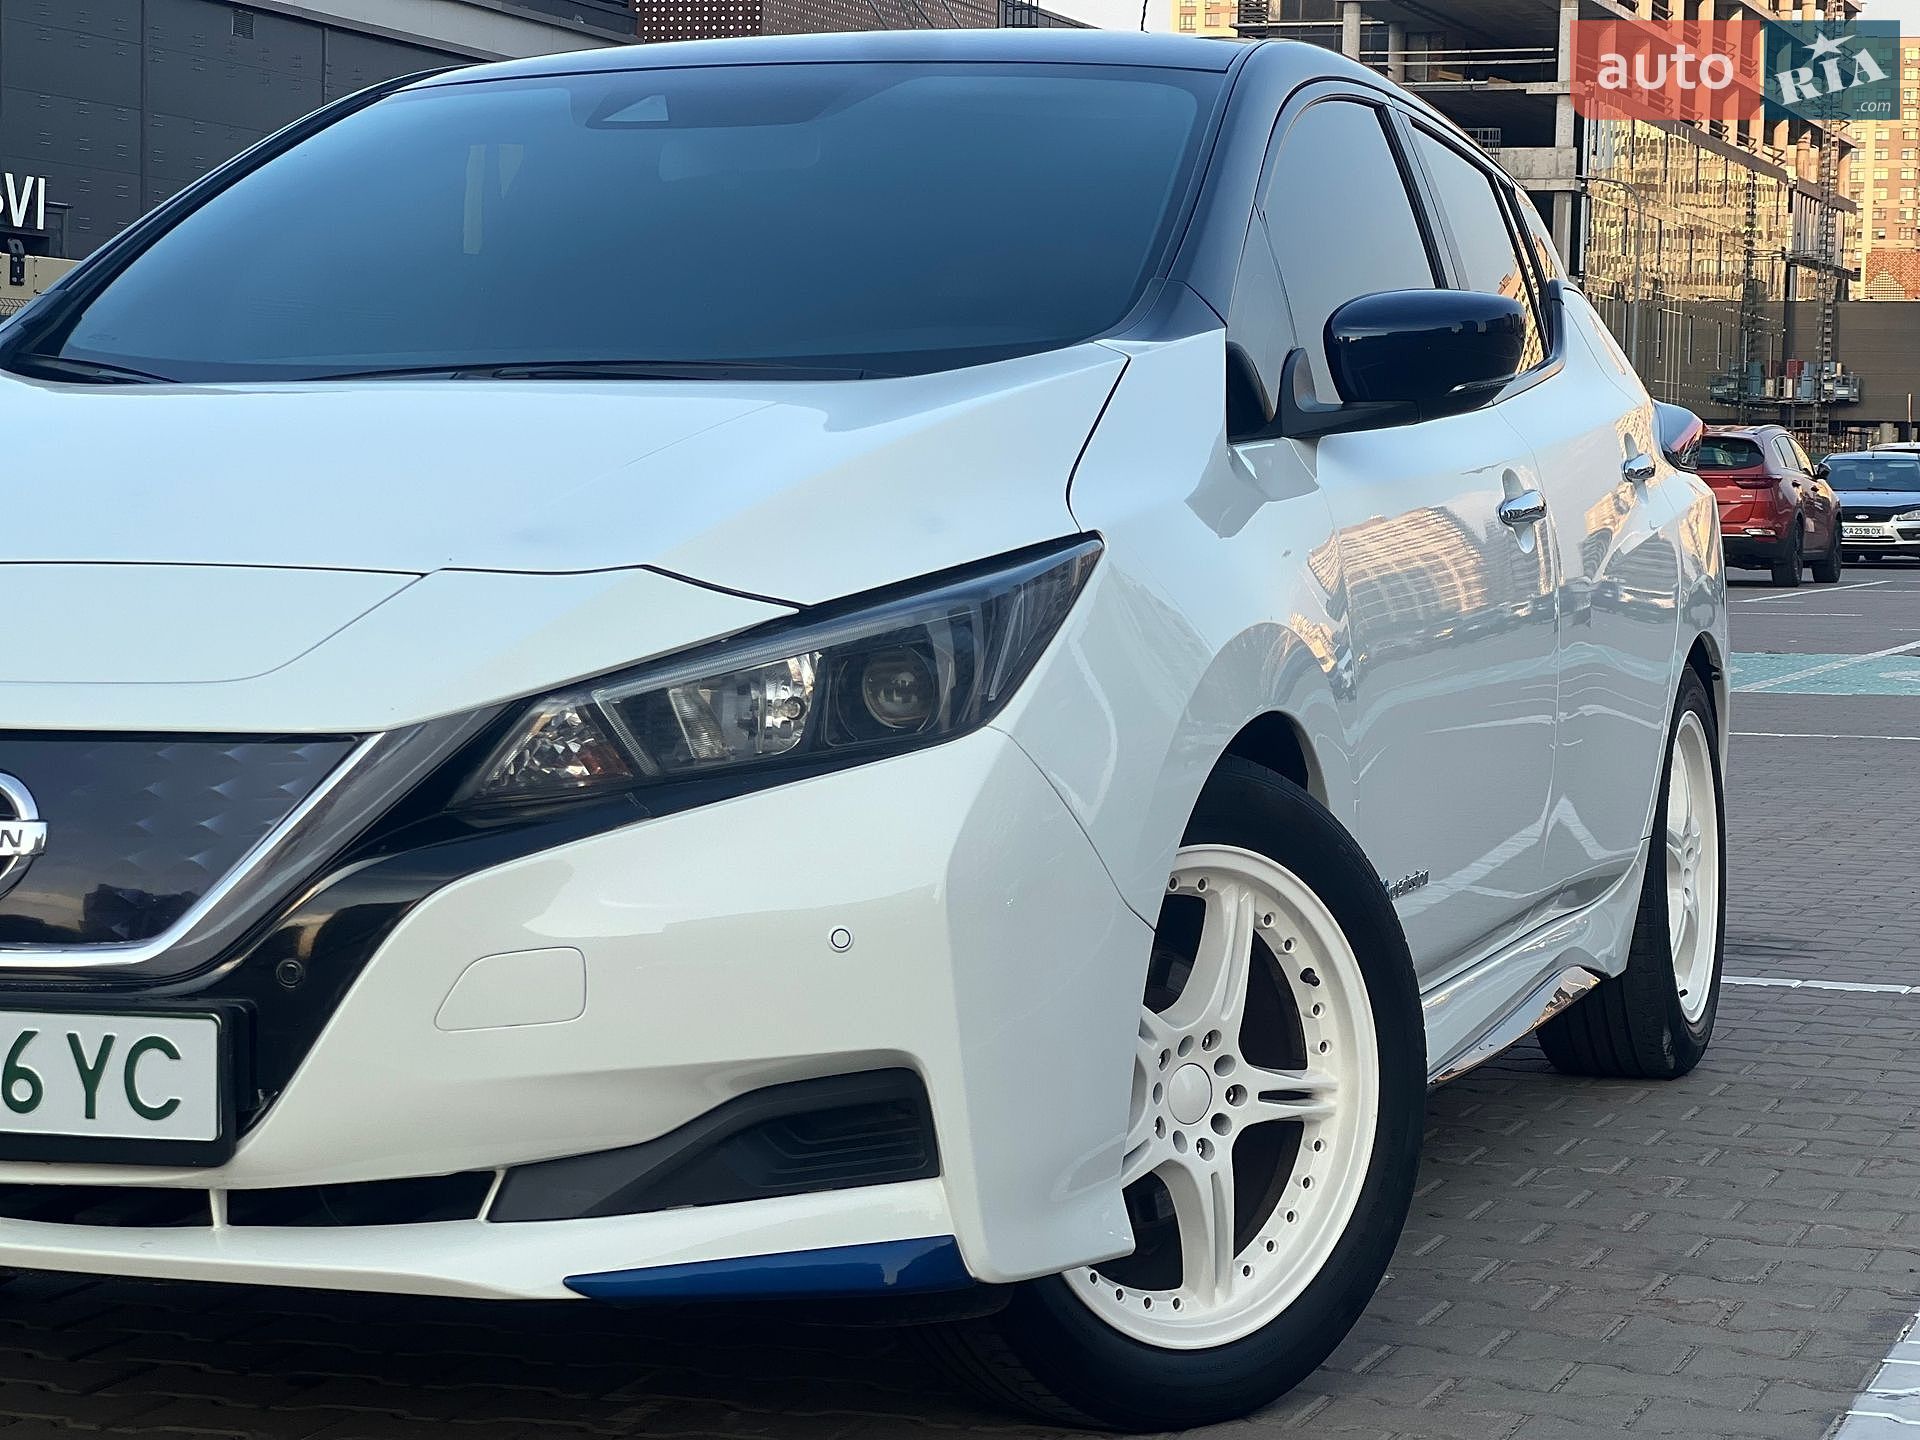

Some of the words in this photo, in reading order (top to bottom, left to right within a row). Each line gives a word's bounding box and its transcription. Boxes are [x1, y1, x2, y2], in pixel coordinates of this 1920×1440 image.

[0, 172, 46, 230] VI
[1, 1030, 44, 1114] 6
[66, 1032, 182, 1121] YC
